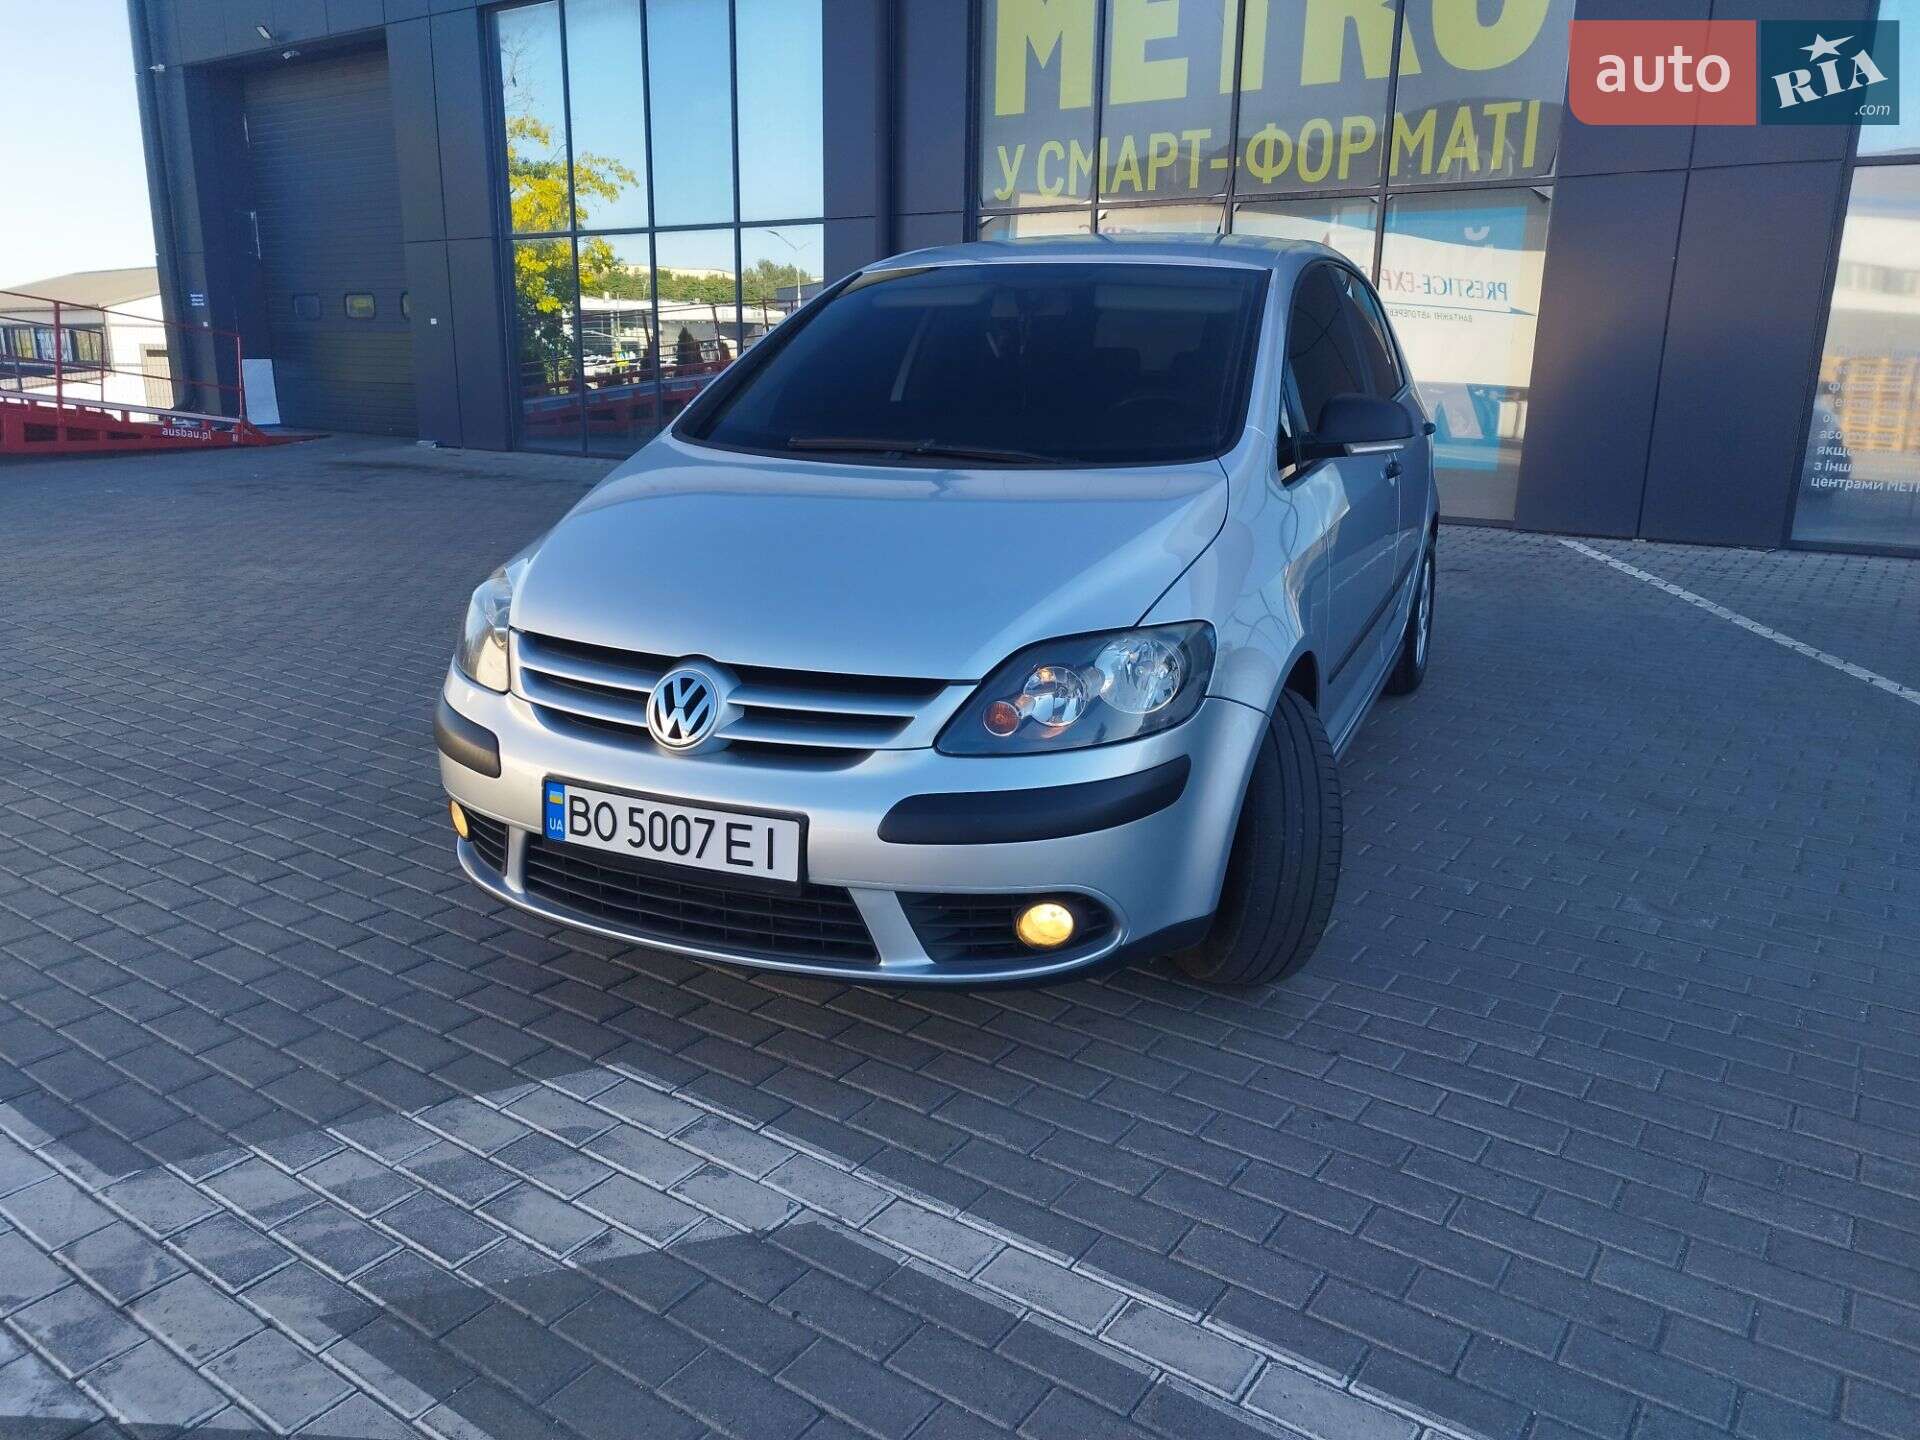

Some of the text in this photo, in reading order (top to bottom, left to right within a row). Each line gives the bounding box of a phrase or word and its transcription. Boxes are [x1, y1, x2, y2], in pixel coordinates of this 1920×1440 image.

[994, 144, 1026, 200] У
[162, 427, 211, 440] ausbau.pl
[1811, 477, 1883, 491] центрами
[549, 794, 774, 870] UA BO 5007 EI
